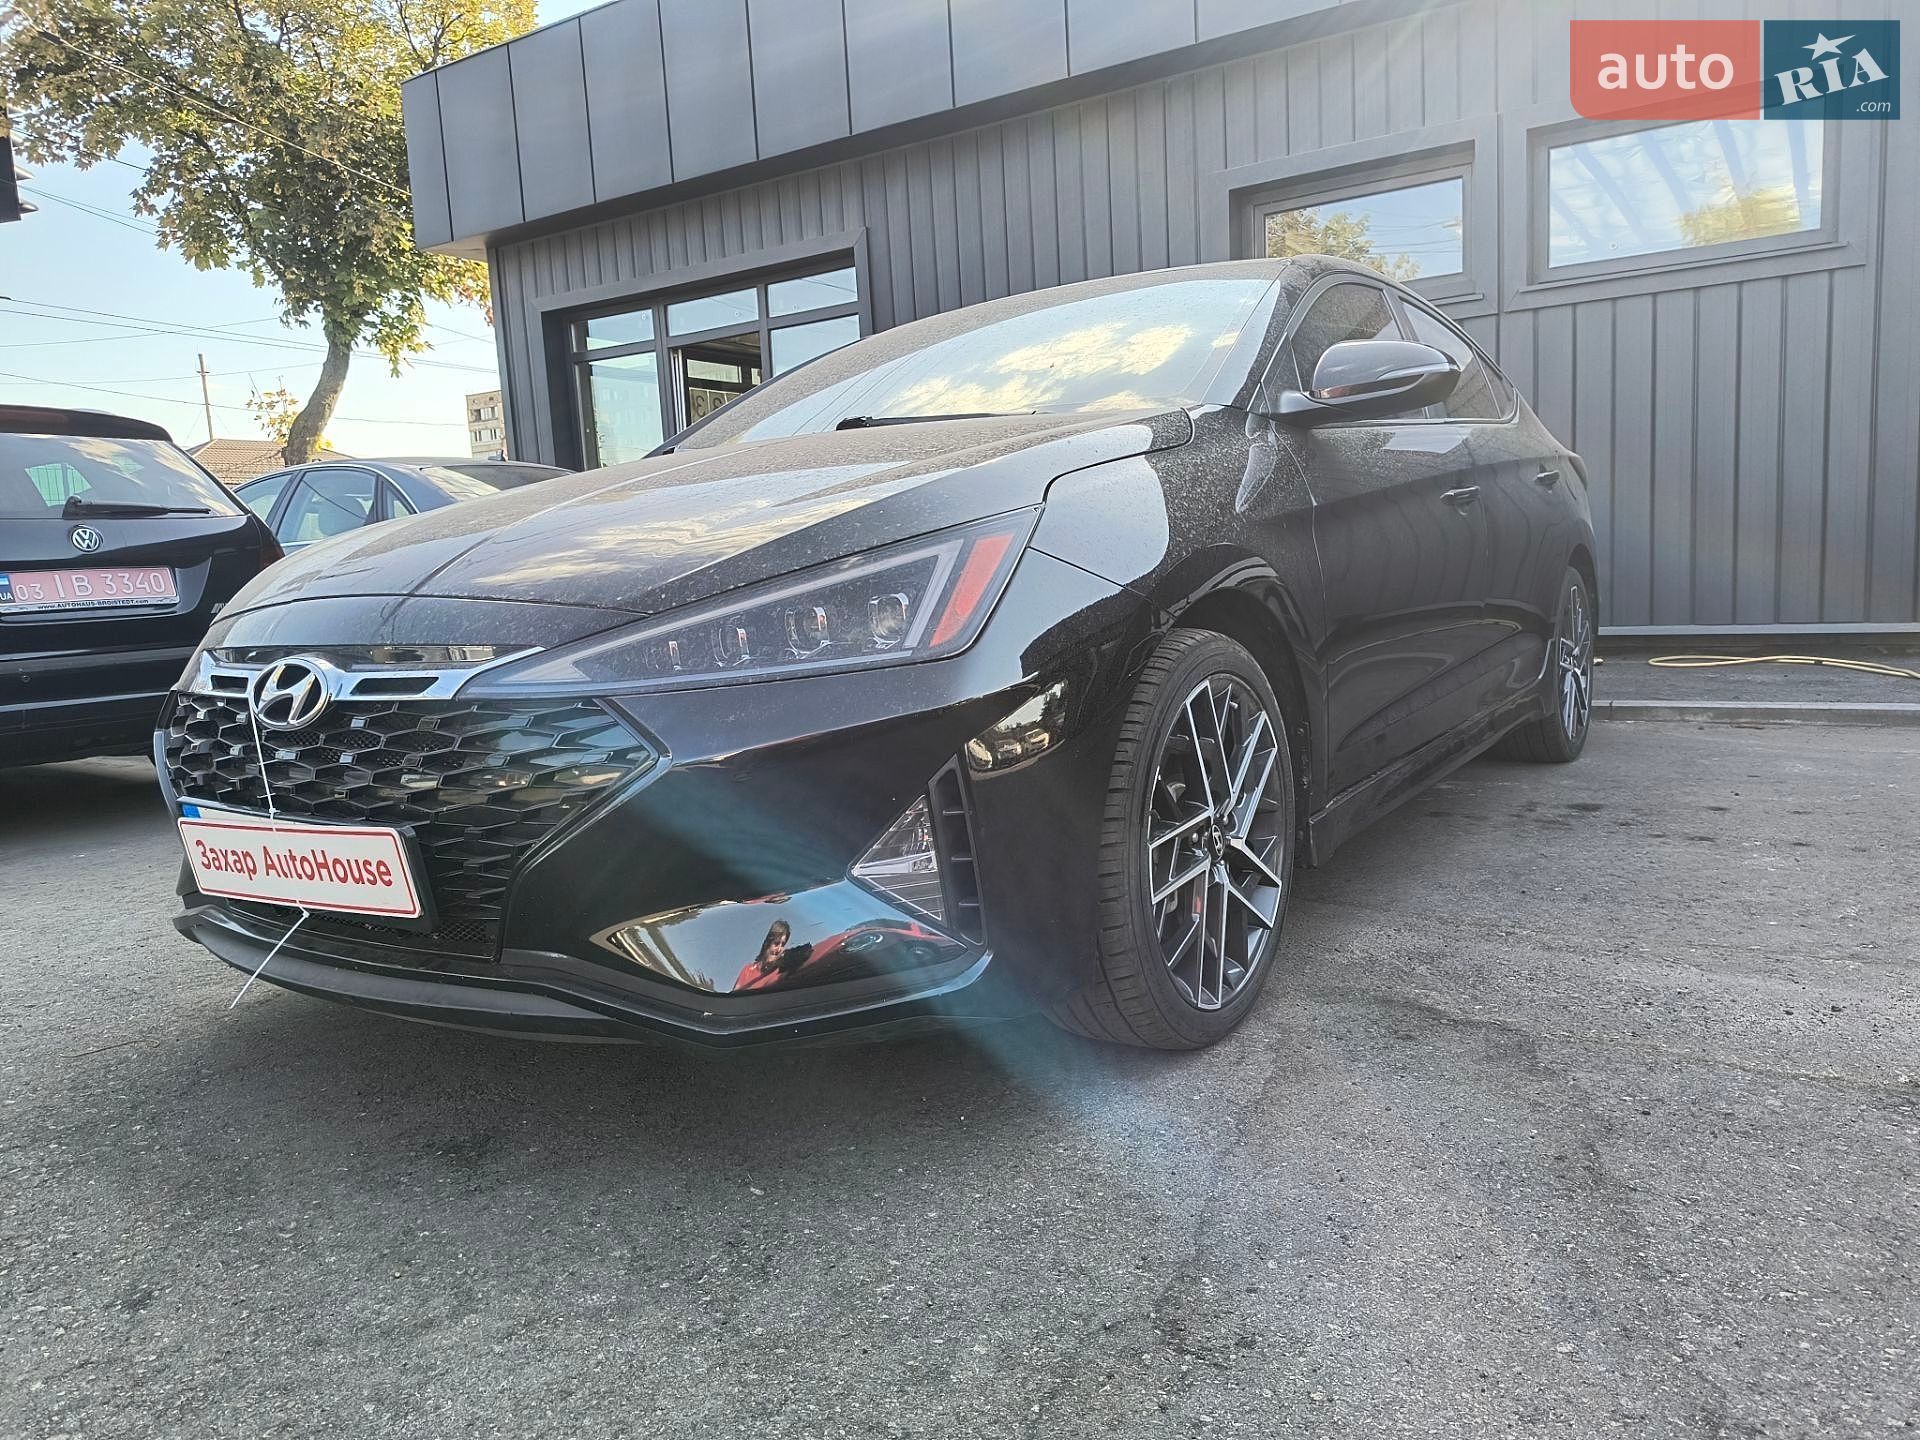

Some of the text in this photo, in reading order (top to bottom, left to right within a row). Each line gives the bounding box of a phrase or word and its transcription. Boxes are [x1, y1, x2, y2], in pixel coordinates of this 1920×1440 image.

[0, 592, 13, 600] UA
[16, 572, 165, 600] 03 IB 3340
[196, 840, 393, 887] Захар AutoHouse
